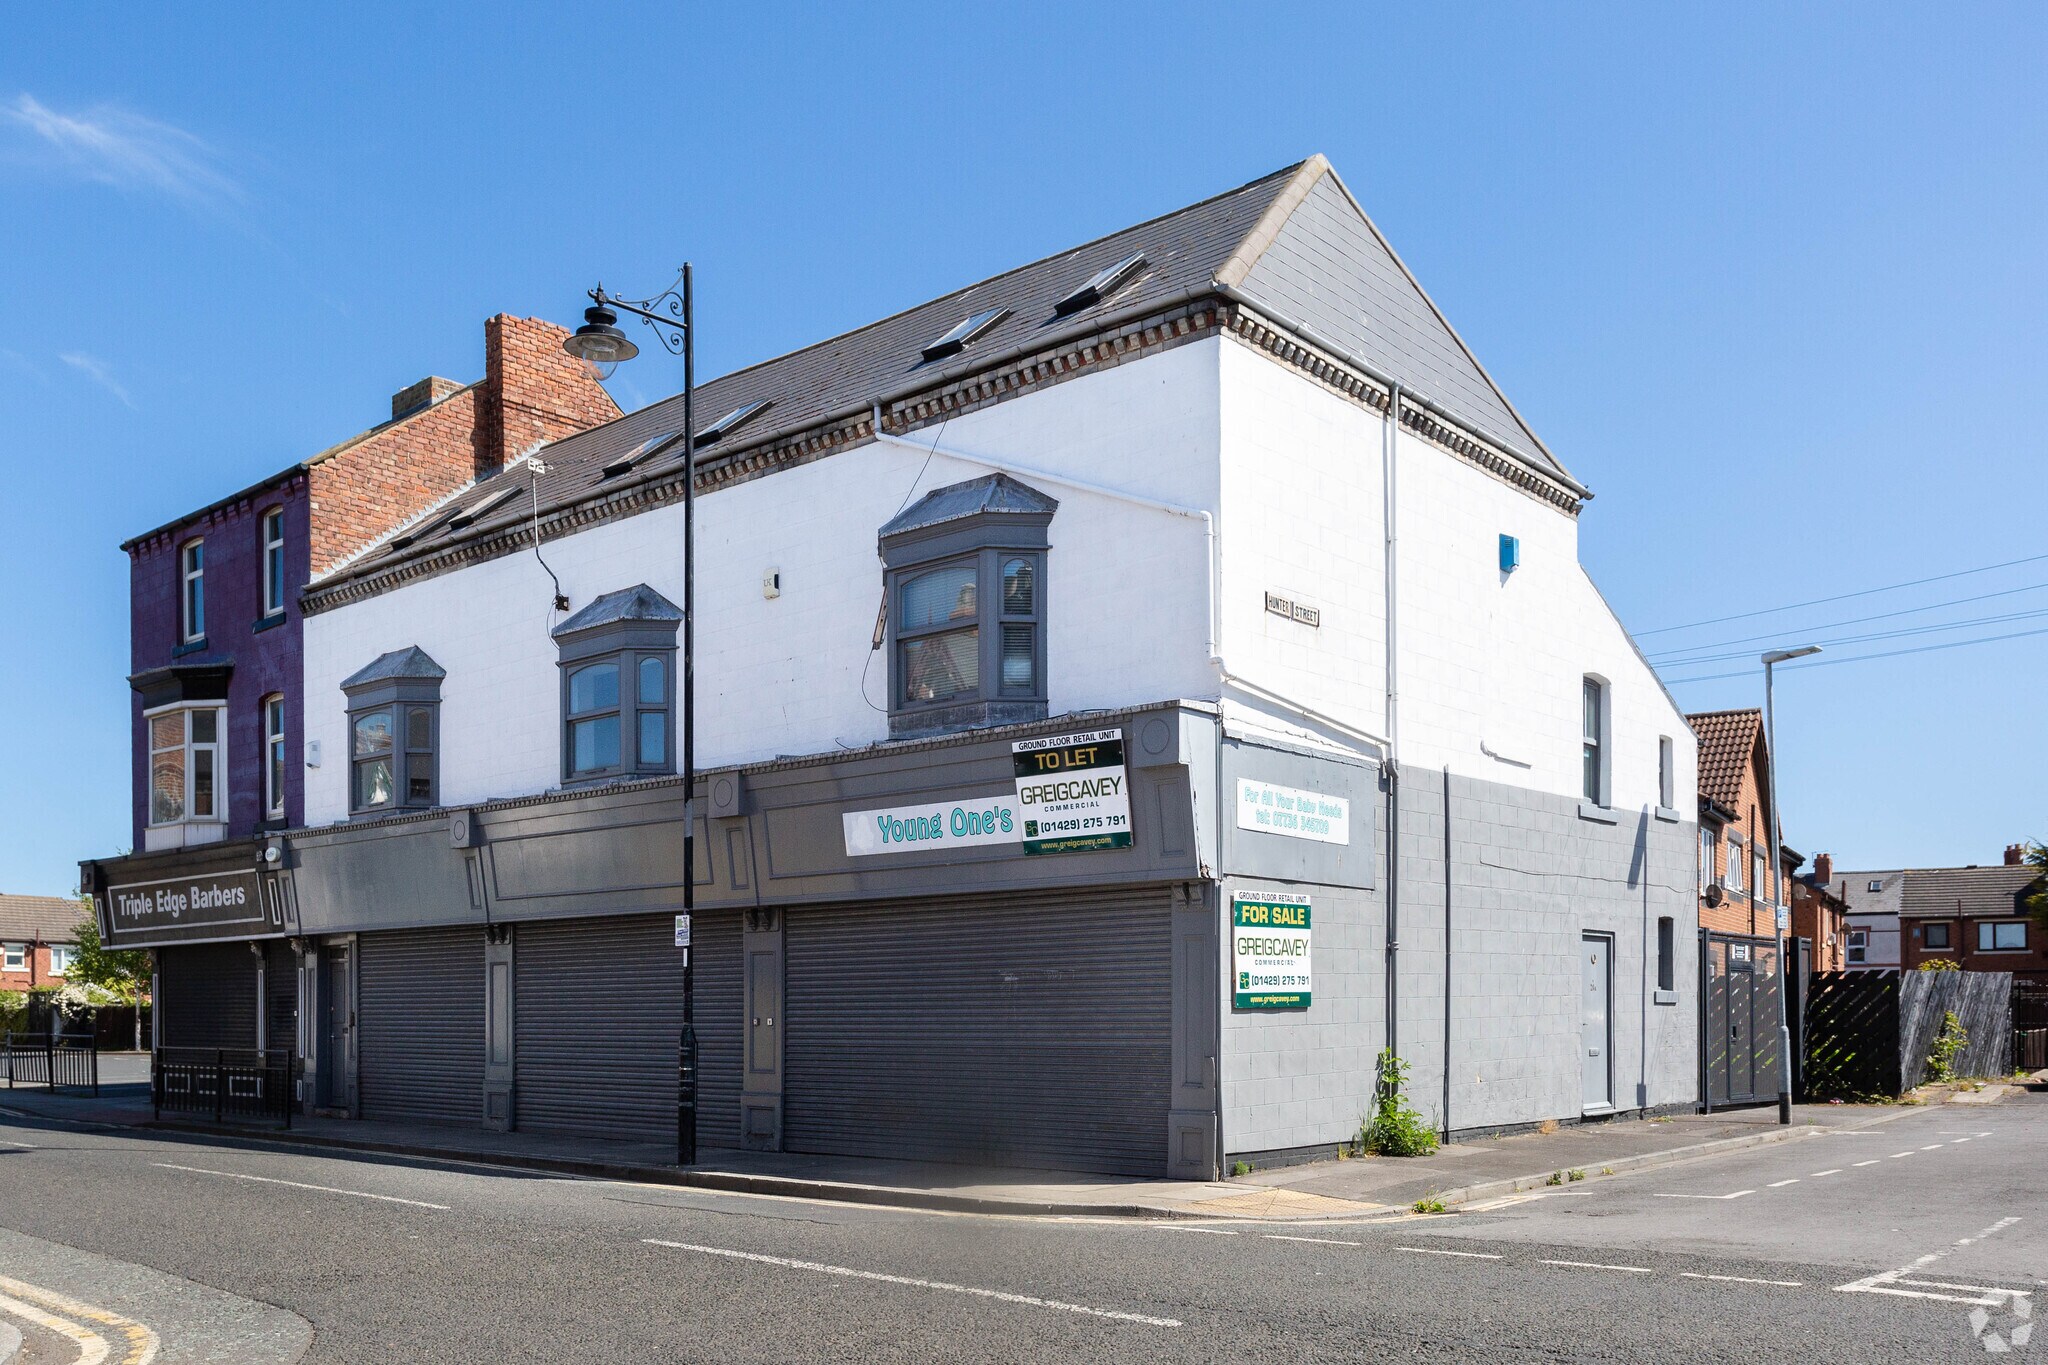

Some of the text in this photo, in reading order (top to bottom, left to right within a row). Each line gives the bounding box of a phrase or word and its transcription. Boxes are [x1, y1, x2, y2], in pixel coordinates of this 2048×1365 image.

[1268, 594, 1317, 623] HUNTER STREET
[1018, 730, 1115, 750] GROUND FLOOR RETAIL UNIT
[1035, 747, 1098, 770] TO LET
[1020, 776, 1121, 805] GREIGCAVEY
[1044, 801, 1100, 812] COMMERCIAL
[1244, 786, 1342, 819] For All Your Baby Needs
[877, 806, 1013, 844] Young One's
[1041, 819, 1080, 833] (01429)
[1083, 817, 1103, 828] 275
[1106, 815, 1126, 826] 791
[1041, 836, 1112, 849] www.greigcavey.com
[118, 884, 246, 920] Triple Edge Barbers
[1239, 891, 1307, 904] GROUND FLOOR RETAIL UNIT
[1241, 905, 1305, 925] FOR SALE
[1237, 937, 1309, 957] GREIGCAVEY
[1251, 975, 1280, 986] (01429)
[1282, 975, 1296, 986] 275
[1297, 975, 1310, 986] 791
[1250, 994, 1300, 1004] www.greigcavey.com
